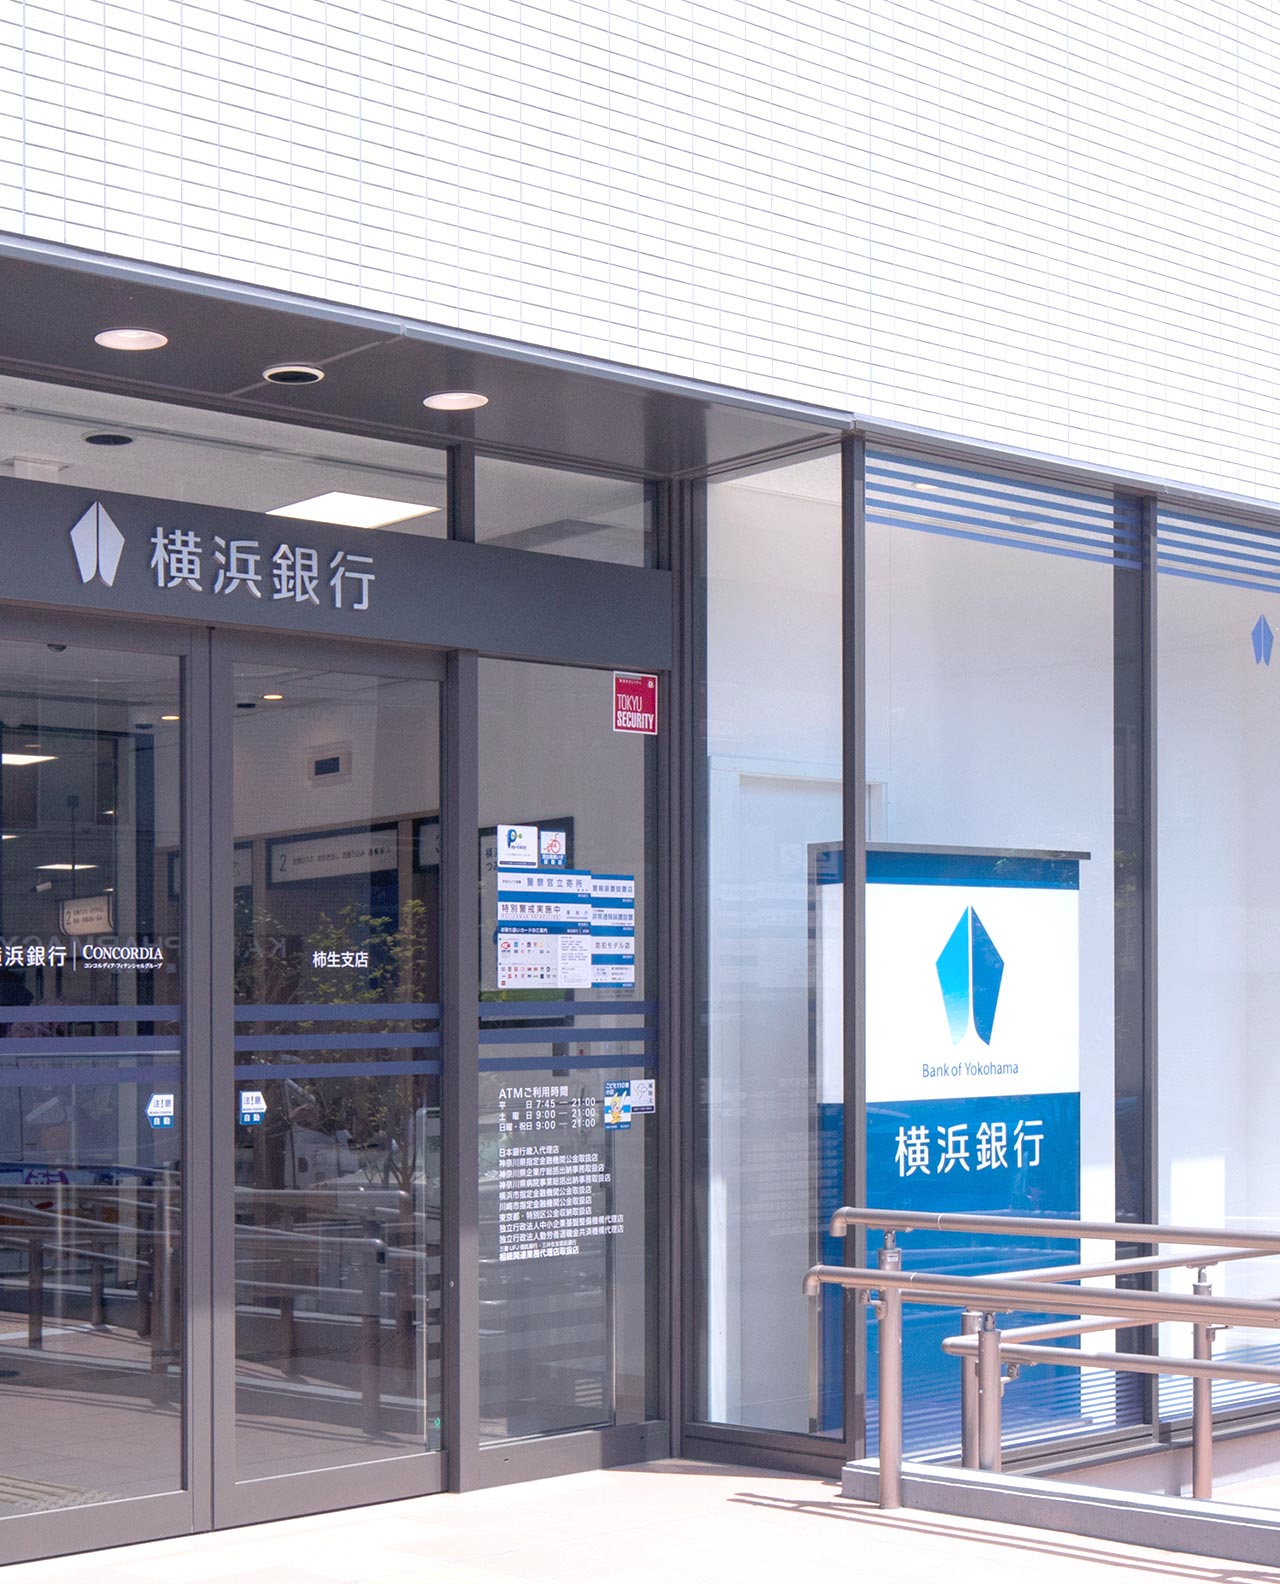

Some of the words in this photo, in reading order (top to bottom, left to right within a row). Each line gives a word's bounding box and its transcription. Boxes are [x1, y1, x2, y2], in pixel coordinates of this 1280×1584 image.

[149, 526, 376, 611] 横浜銀行
[616, 693, 643, 712] TOKYU
[616, 710, 654, 730] SECURITY
[82, 944, 164, 960] CONCORDIA
[312, 951, 369, 968] 柿生支店
[922, 1062, 950, 1078] Bank
[951, 1061, 962, 1077] of
[964, 1061, 1019, 1076] Yokohama
[499, 1085, 569, 1100] ATMご利用時間
[535, 1098, 556, 1109] 7:45
[571, 1096, 596, 1108] 21:00
[535, 1109, 556, 1120] 9:00
[571, 1107, 596, 1118] 21:00
[535, 1120, 556, 1131] 9:00
[571, 1117, 596, 1129] 21:00
[895, 1119, 1044, 1178] 横浜銀行
